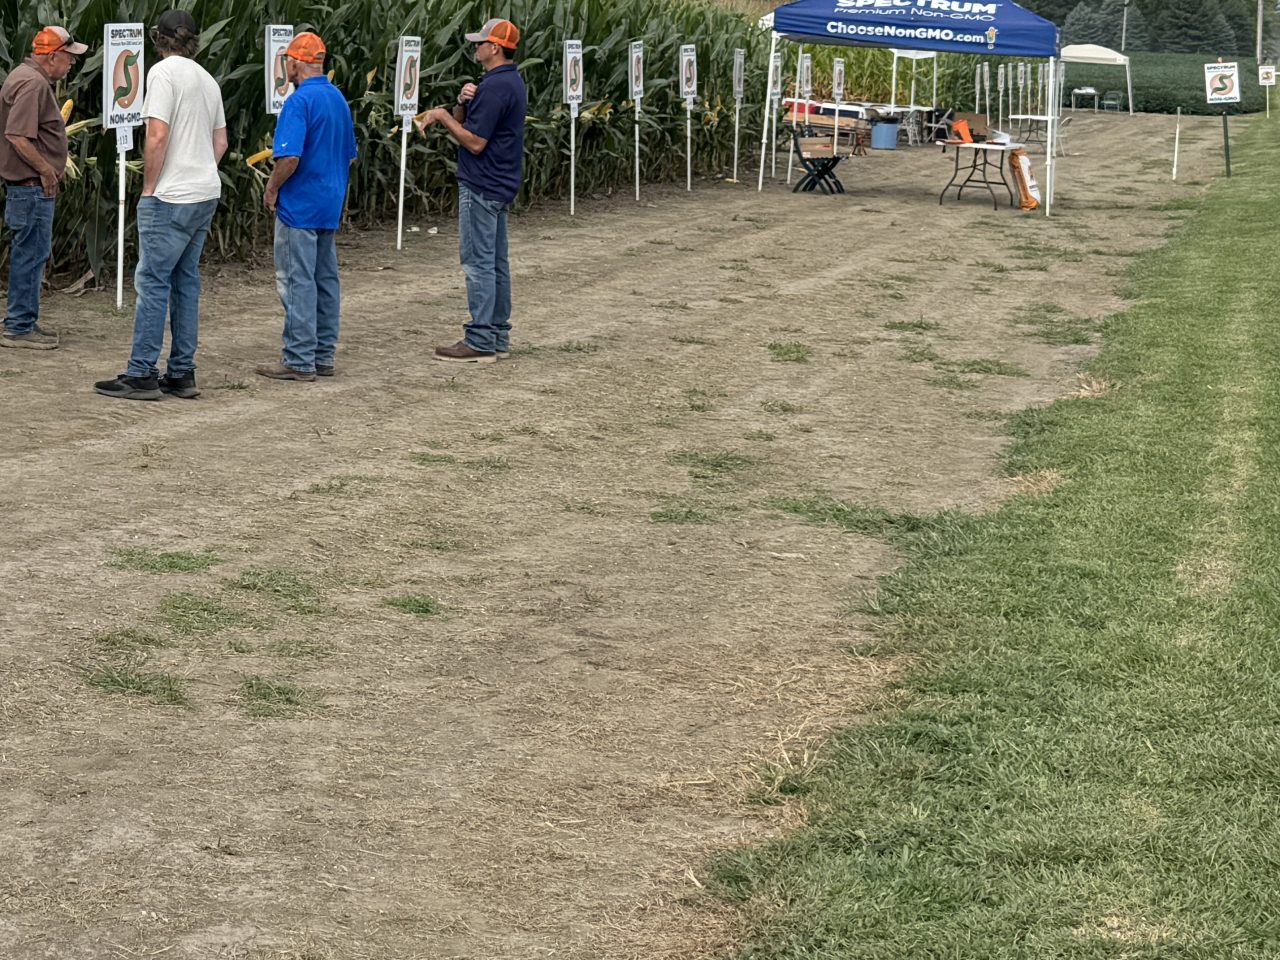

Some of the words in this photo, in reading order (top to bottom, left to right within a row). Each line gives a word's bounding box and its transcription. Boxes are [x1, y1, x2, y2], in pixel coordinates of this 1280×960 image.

[834, 7, 906, 15] Premium
[910, 7, 996, 22] Non-GMO
[110, 28, 143, 39] SPECTRUM
[826, 21, 984, 44] ChooseNonGMO.com
